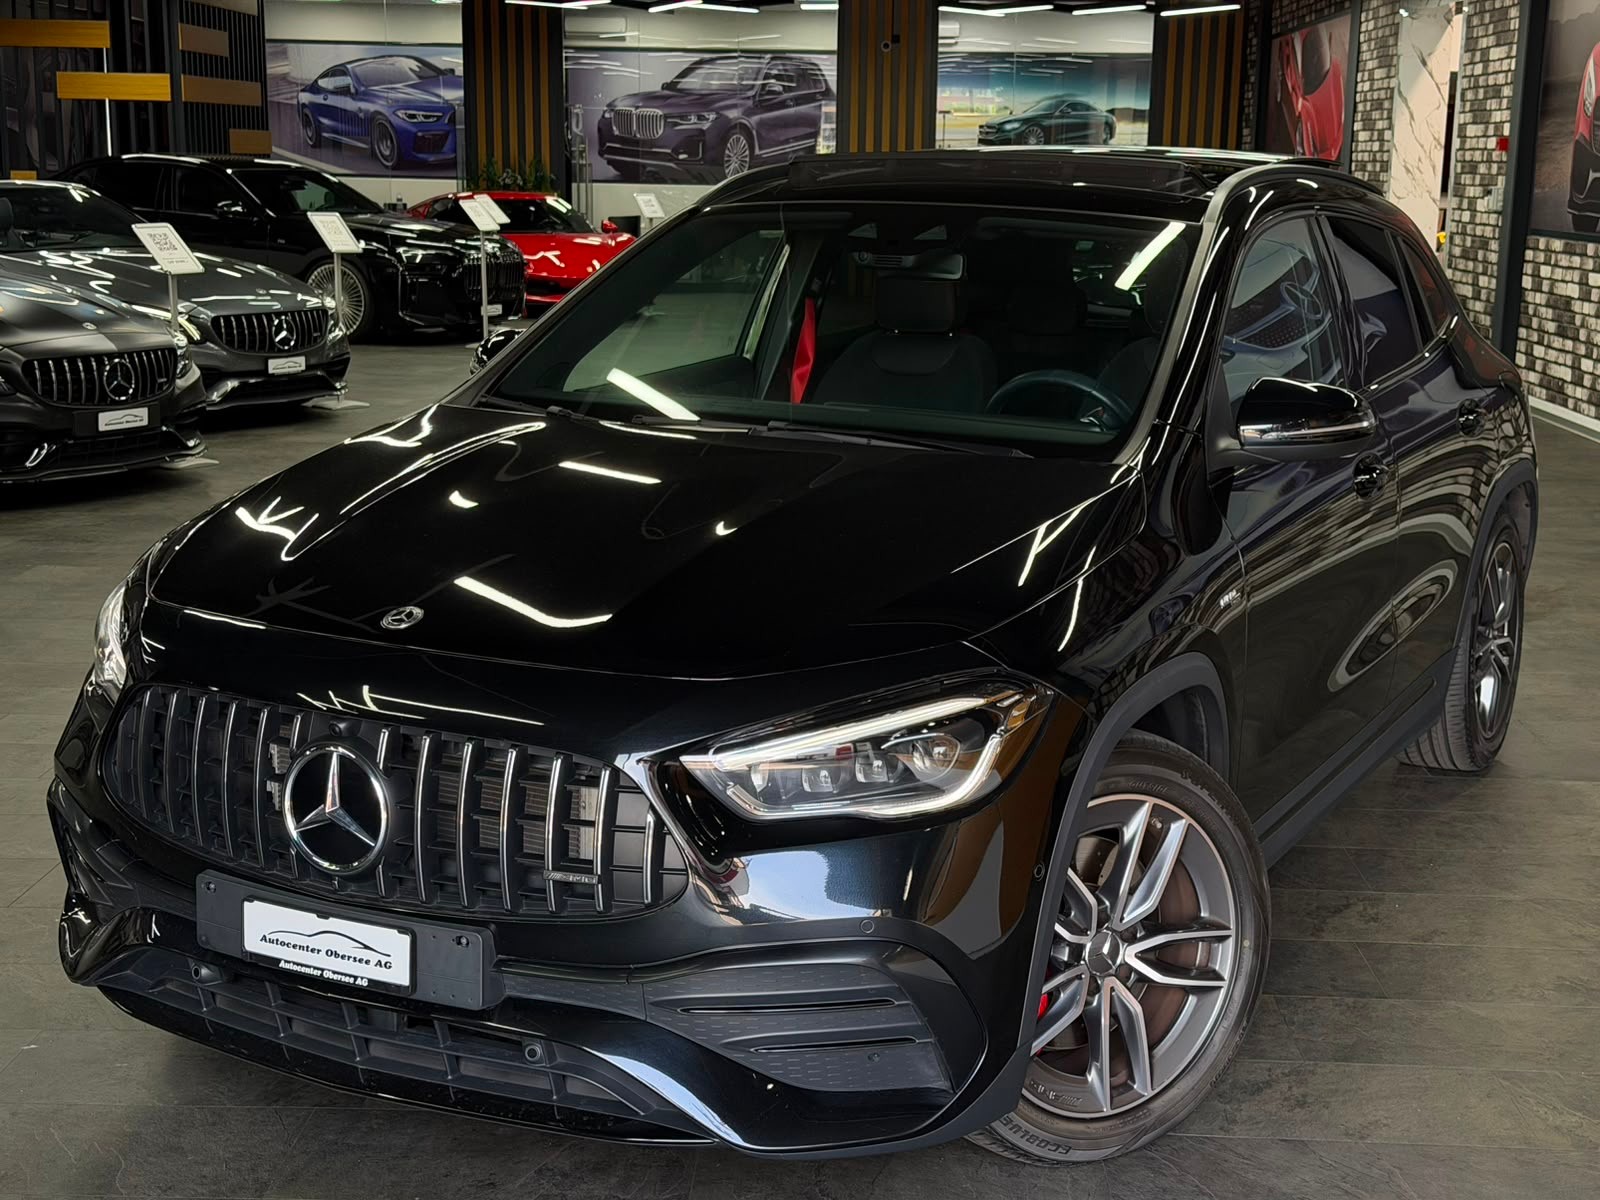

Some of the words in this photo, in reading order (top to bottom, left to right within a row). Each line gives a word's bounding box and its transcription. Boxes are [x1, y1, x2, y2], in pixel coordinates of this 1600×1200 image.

[260, 934, 322, 955] Autocenter
[325, 948, 371, 966] Obersee
[374, 959, 393, 970] AG
[279, 960, 322, 977] Autocenter
[323, 970, 355, 984] Obersee
[355, 977, 369, 987] AG
[1000, 1115, 1072, 1155] ECOBLUE
